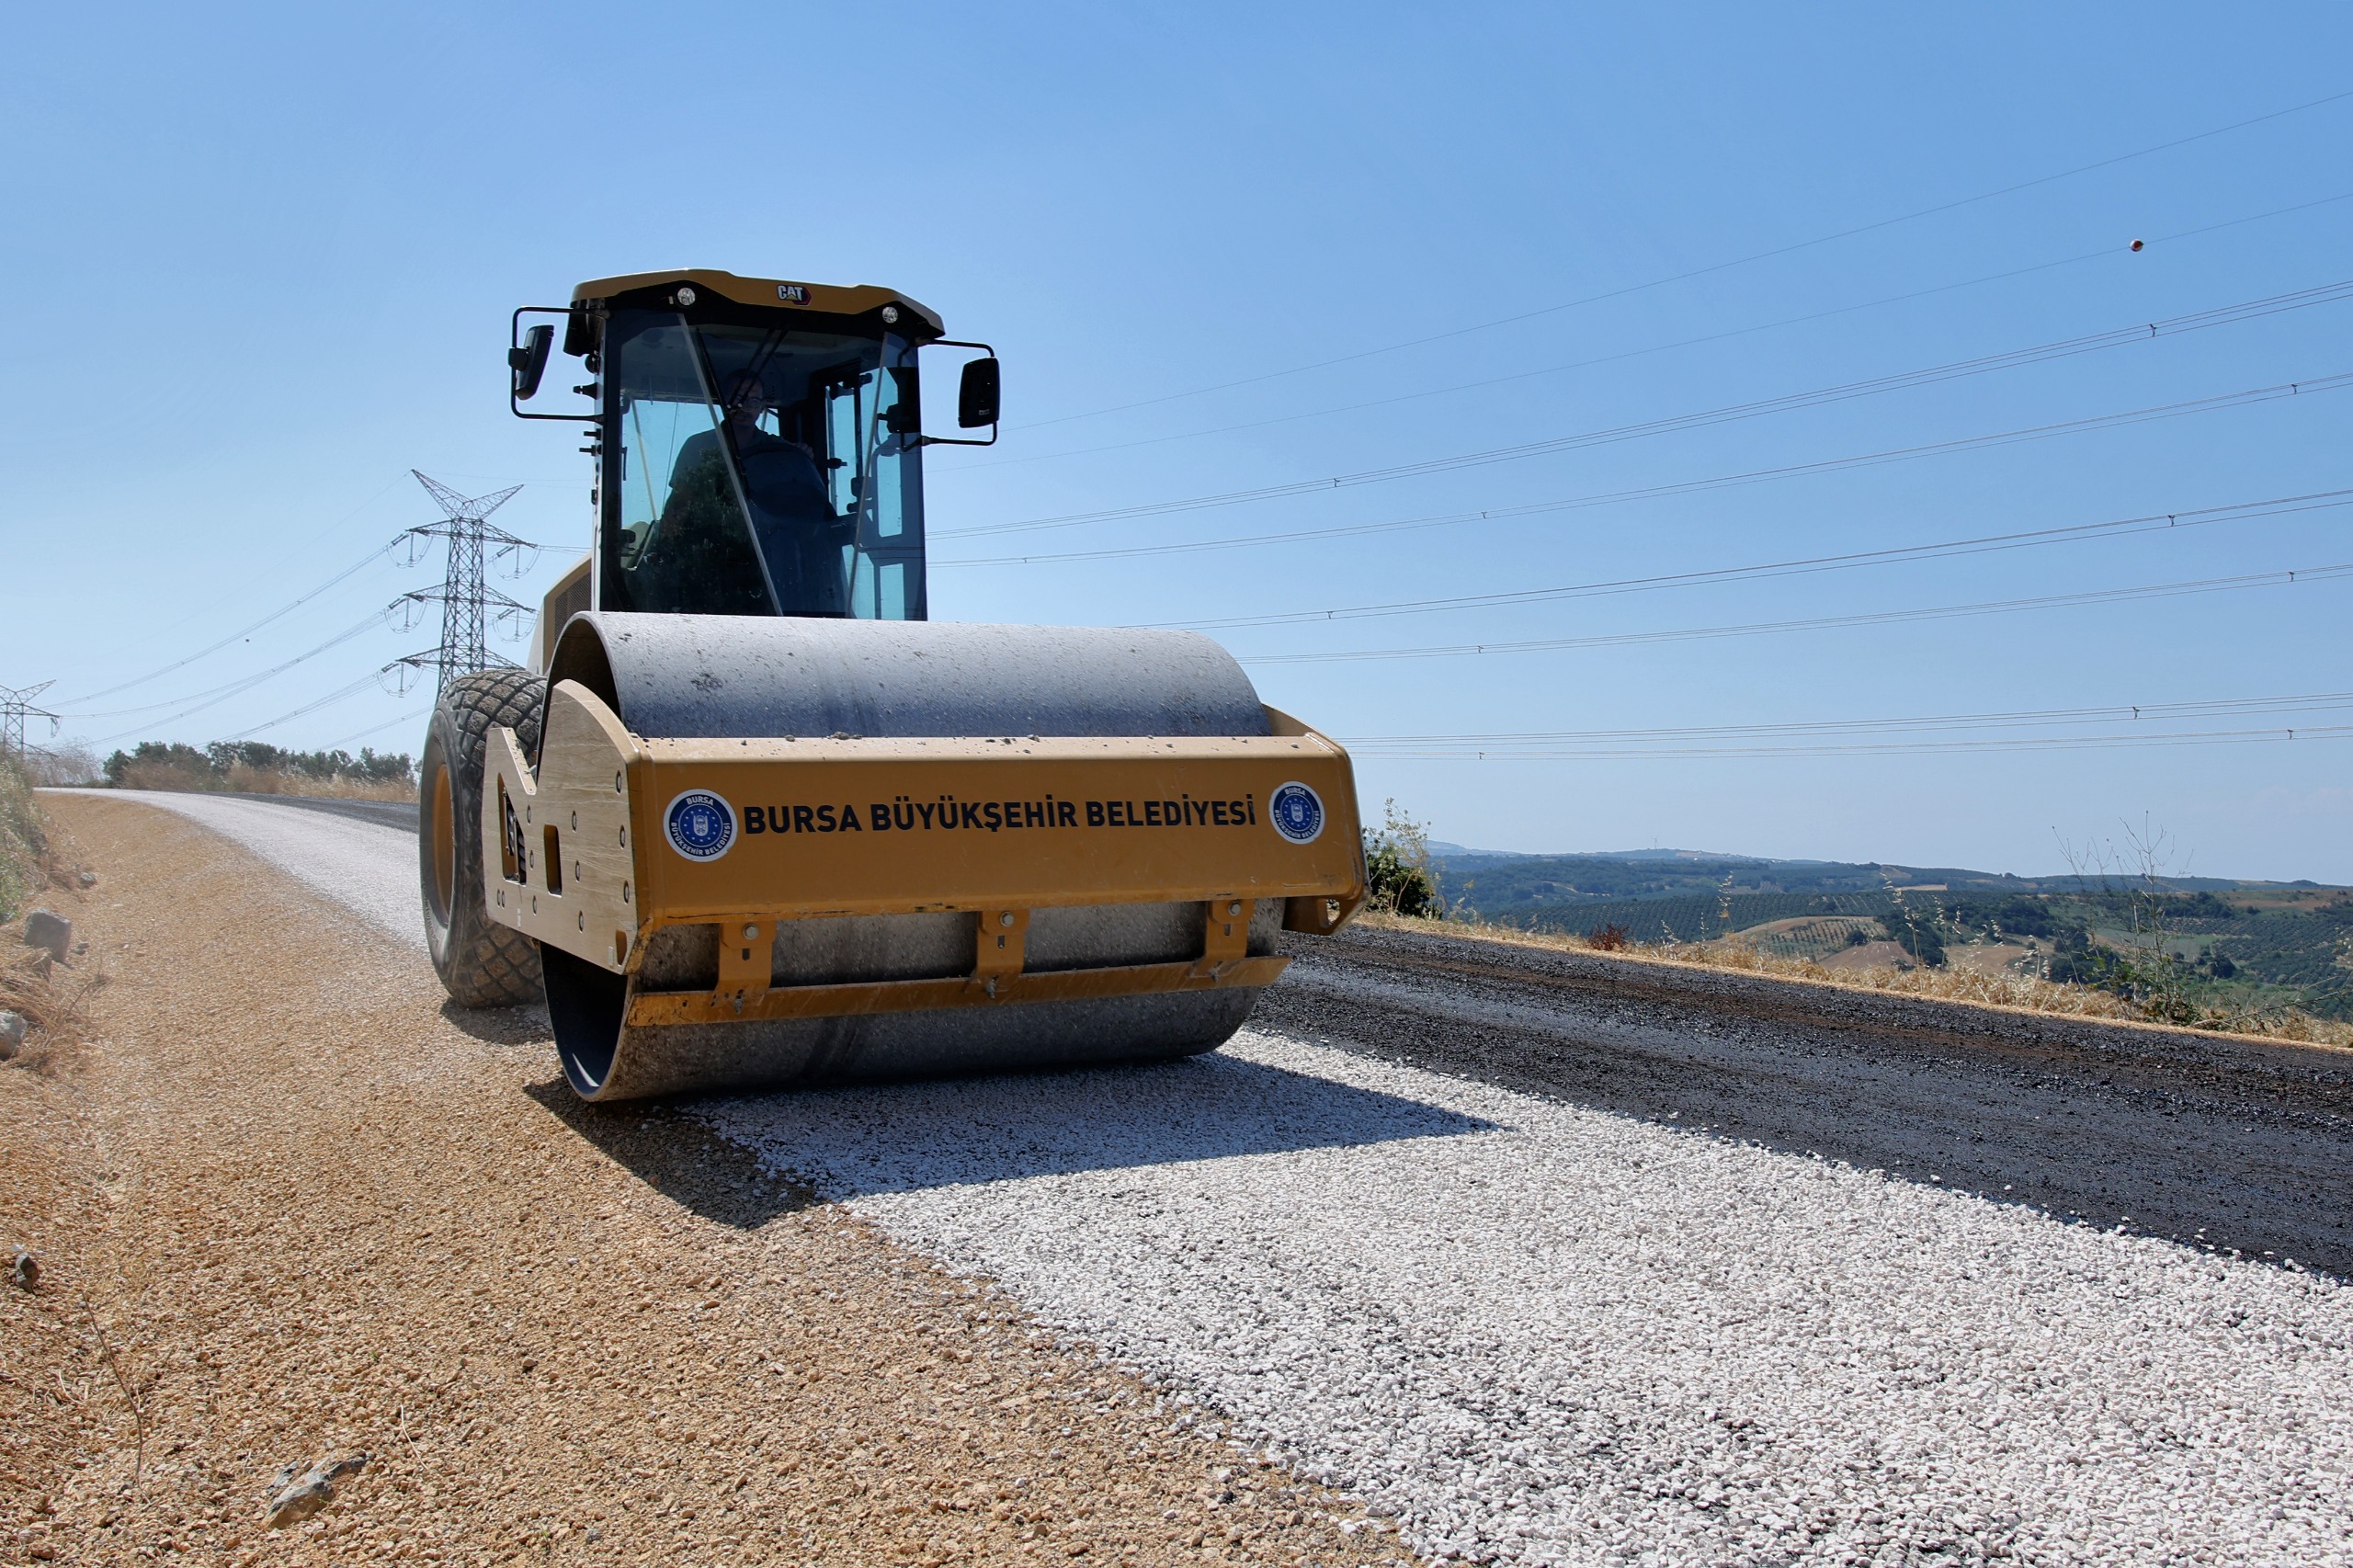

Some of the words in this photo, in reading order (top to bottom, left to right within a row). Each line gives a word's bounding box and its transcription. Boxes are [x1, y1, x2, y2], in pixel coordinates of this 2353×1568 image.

[778, 285, 803, 301] CAT
[686, 795, 714, 806] BURSA
[1284, 788, 1306, 797] BURSA
[743, 803, 862, 835] BURSA
[870, 794, 1078, 832] BÜYÜKŞEHİR
[1085, 793, 1256, 826] BELEDİYESİ
[670, 822, 704, 856] BÜYÜKŞEHİR
